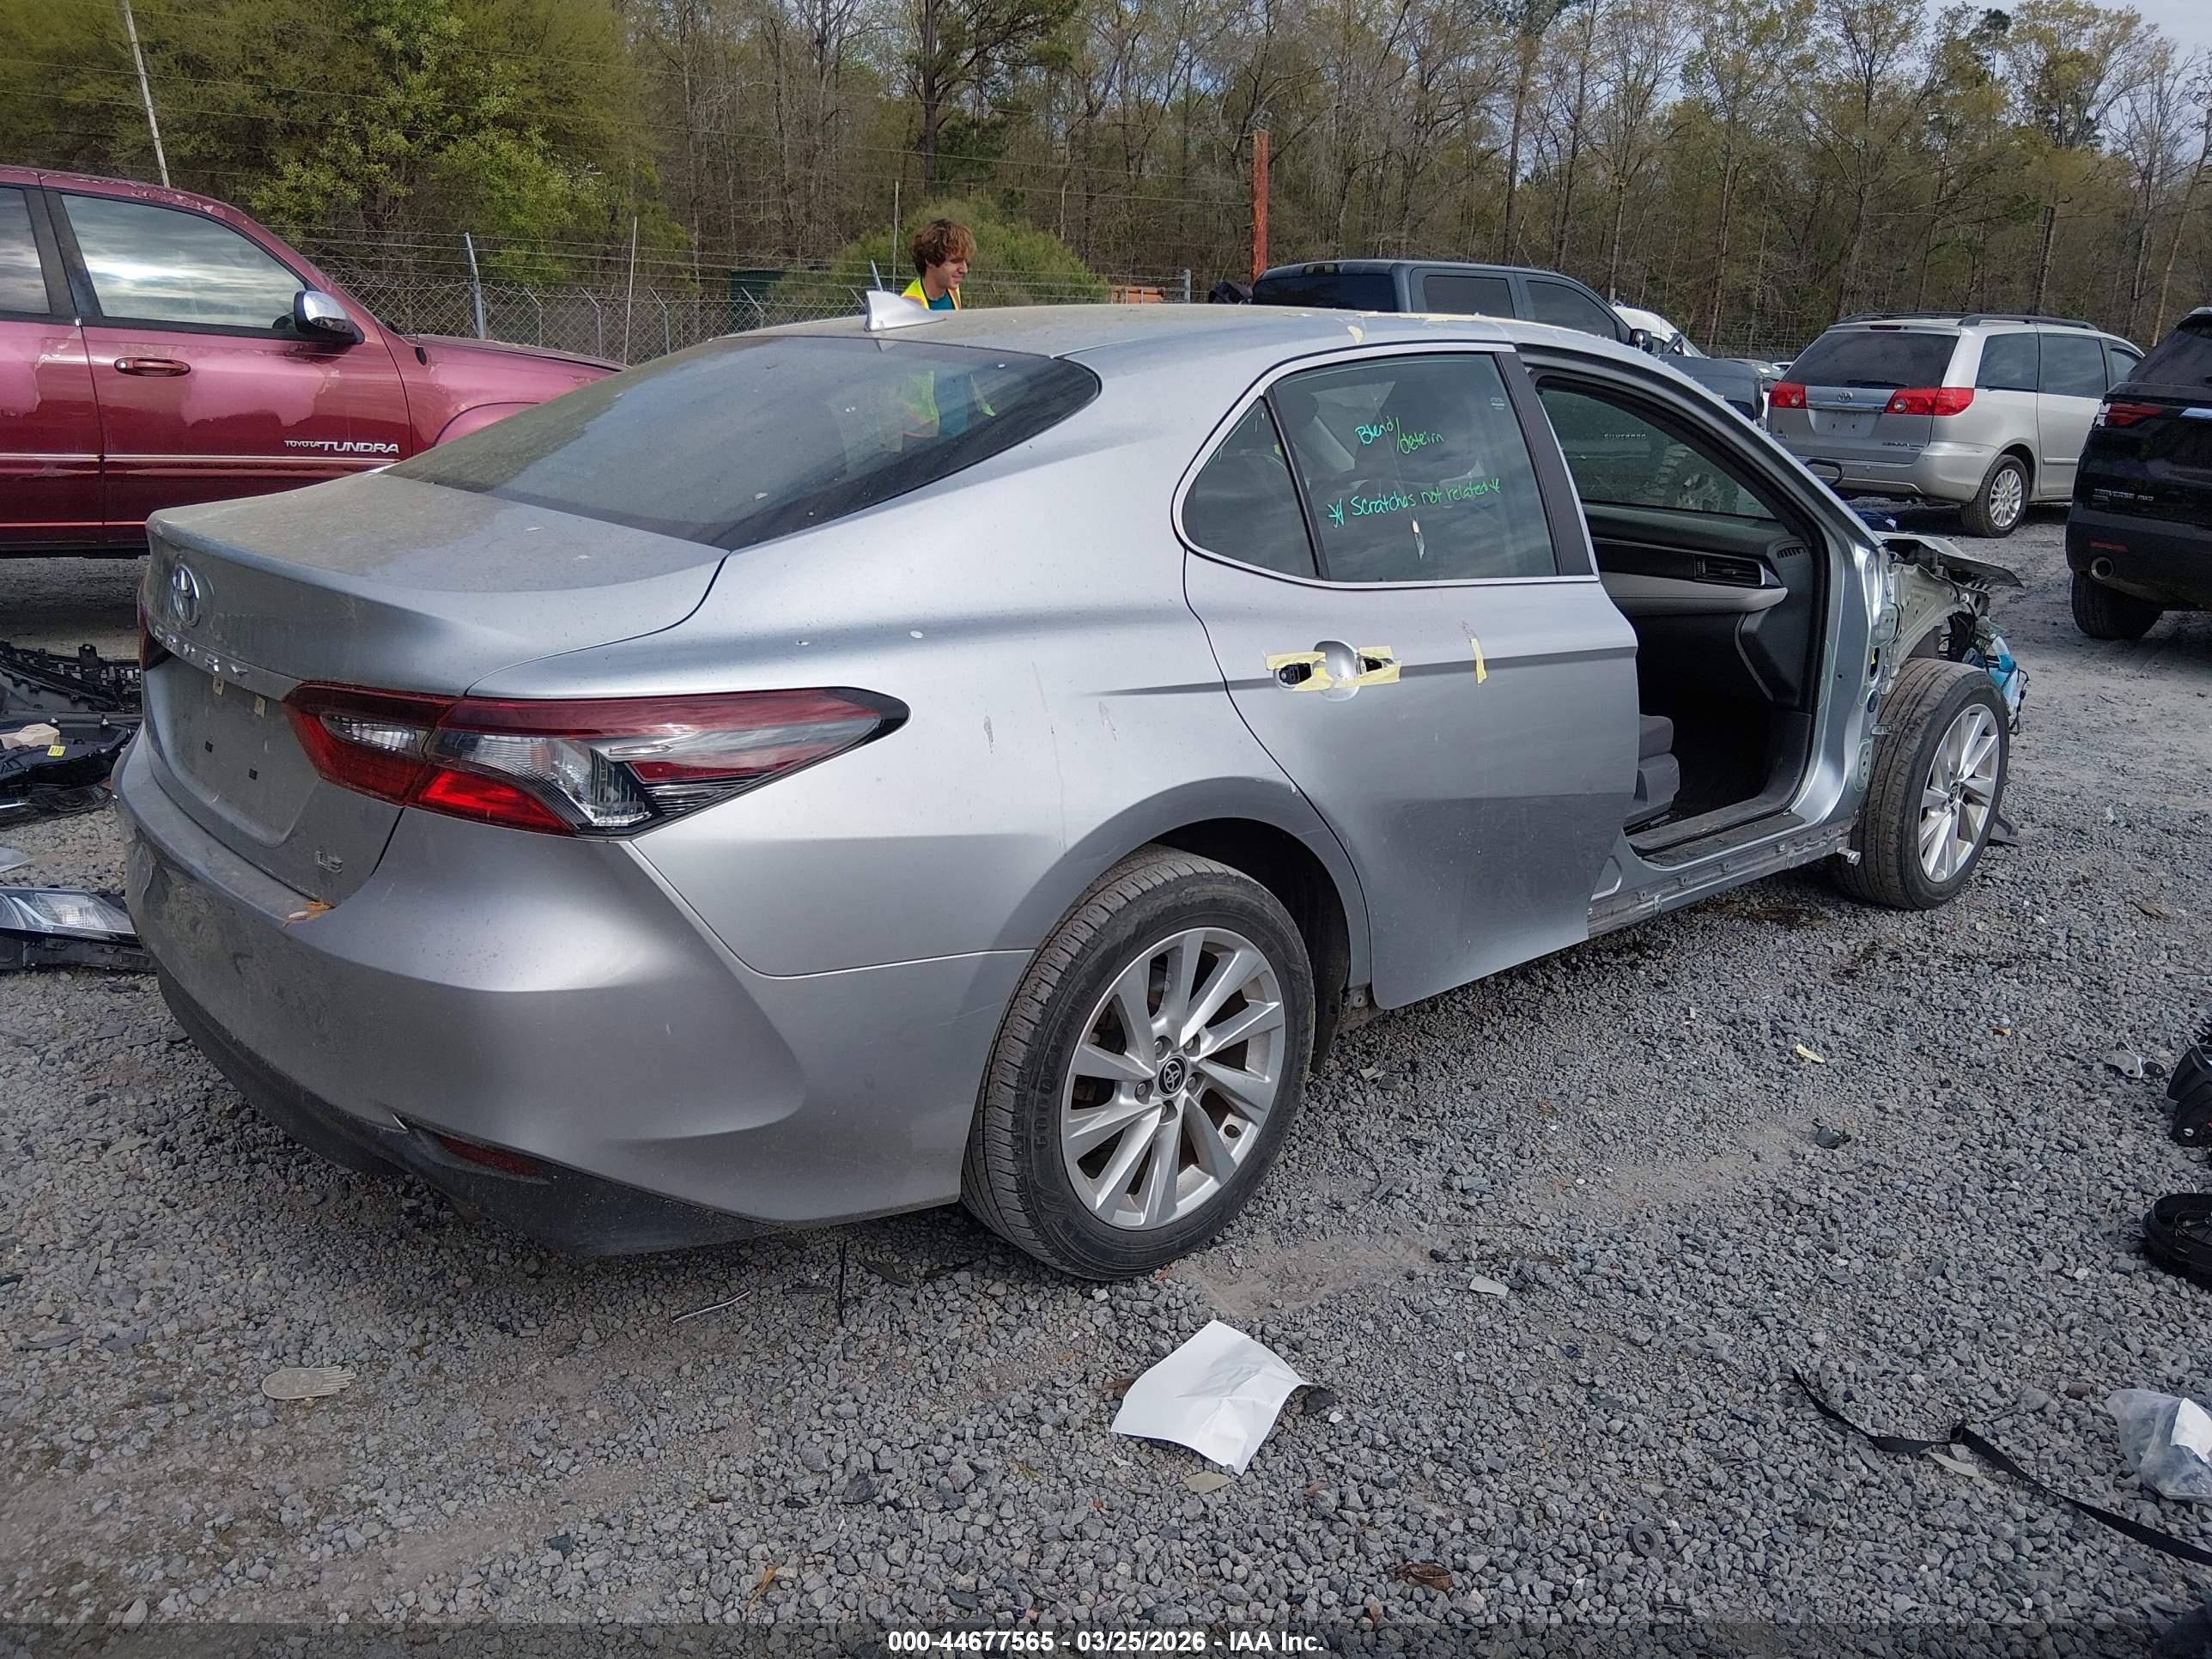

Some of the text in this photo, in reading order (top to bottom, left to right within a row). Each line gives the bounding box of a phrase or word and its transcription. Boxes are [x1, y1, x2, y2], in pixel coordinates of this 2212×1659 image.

[319, 441, 399, 454] TUNDRA
[1420, 487, 1442, 504] not
[315, 850, 344, 874] LE
